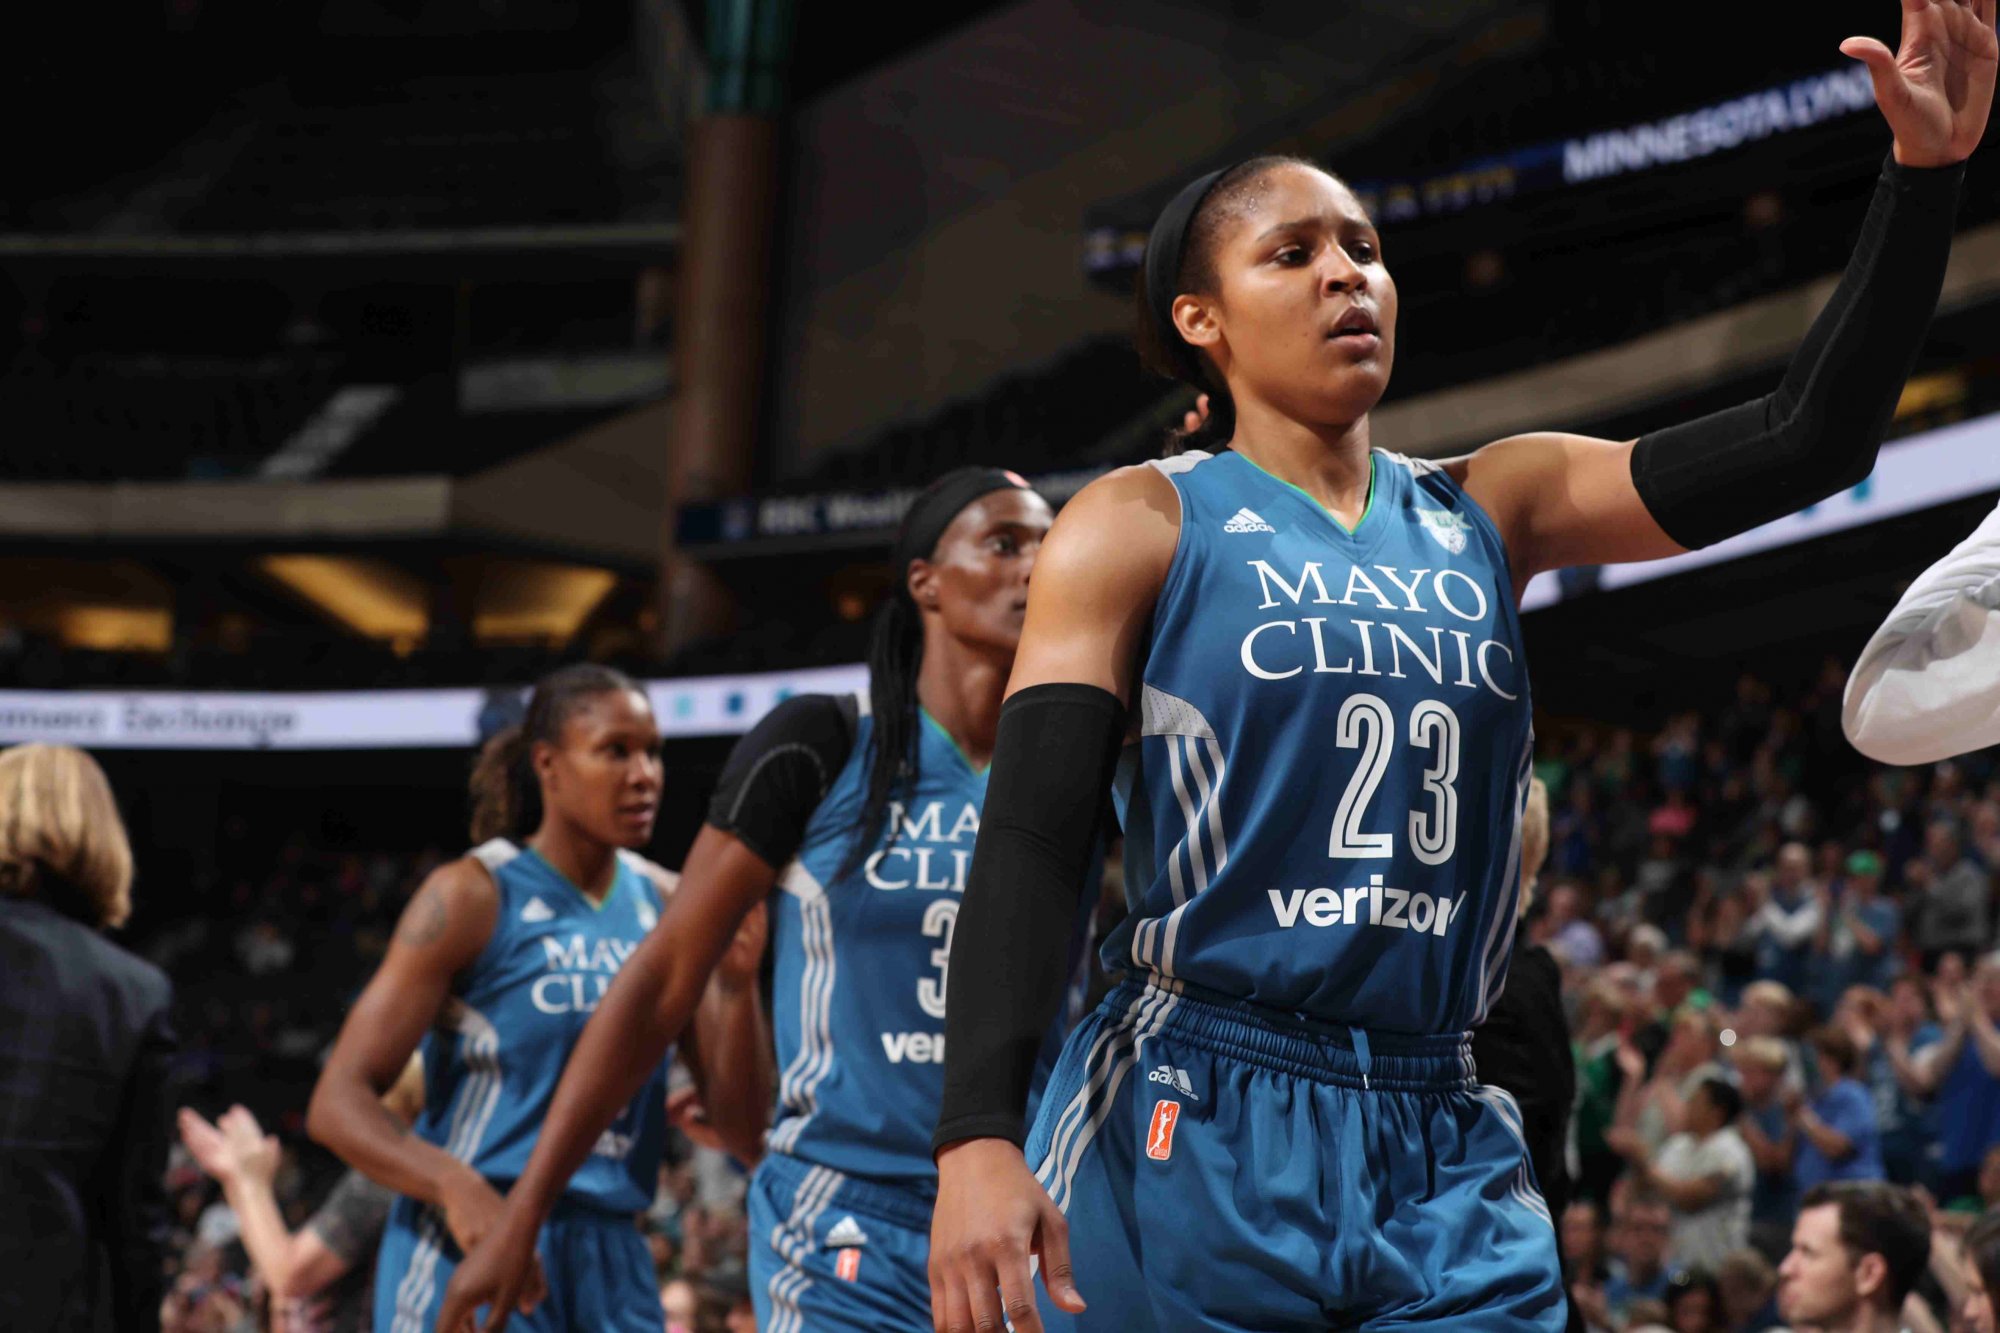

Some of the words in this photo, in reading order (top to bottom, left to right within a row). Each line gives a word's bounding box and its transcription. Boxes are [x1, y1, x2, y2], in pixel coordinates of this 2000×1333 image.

[1562, 88, 1787, 184] MINNESOTA
[1788, 62, 1877, 127] LYN
[1223, 522, 1276, 534] adidas
[1246, 559, 1487, 622] MAYO
[1240, 617, 1517, 701] CLINIC
[1328, 692, 1461, 866] 23
[886, 801, 980, 843] MA
[864, 846, 971, 893] CLI
